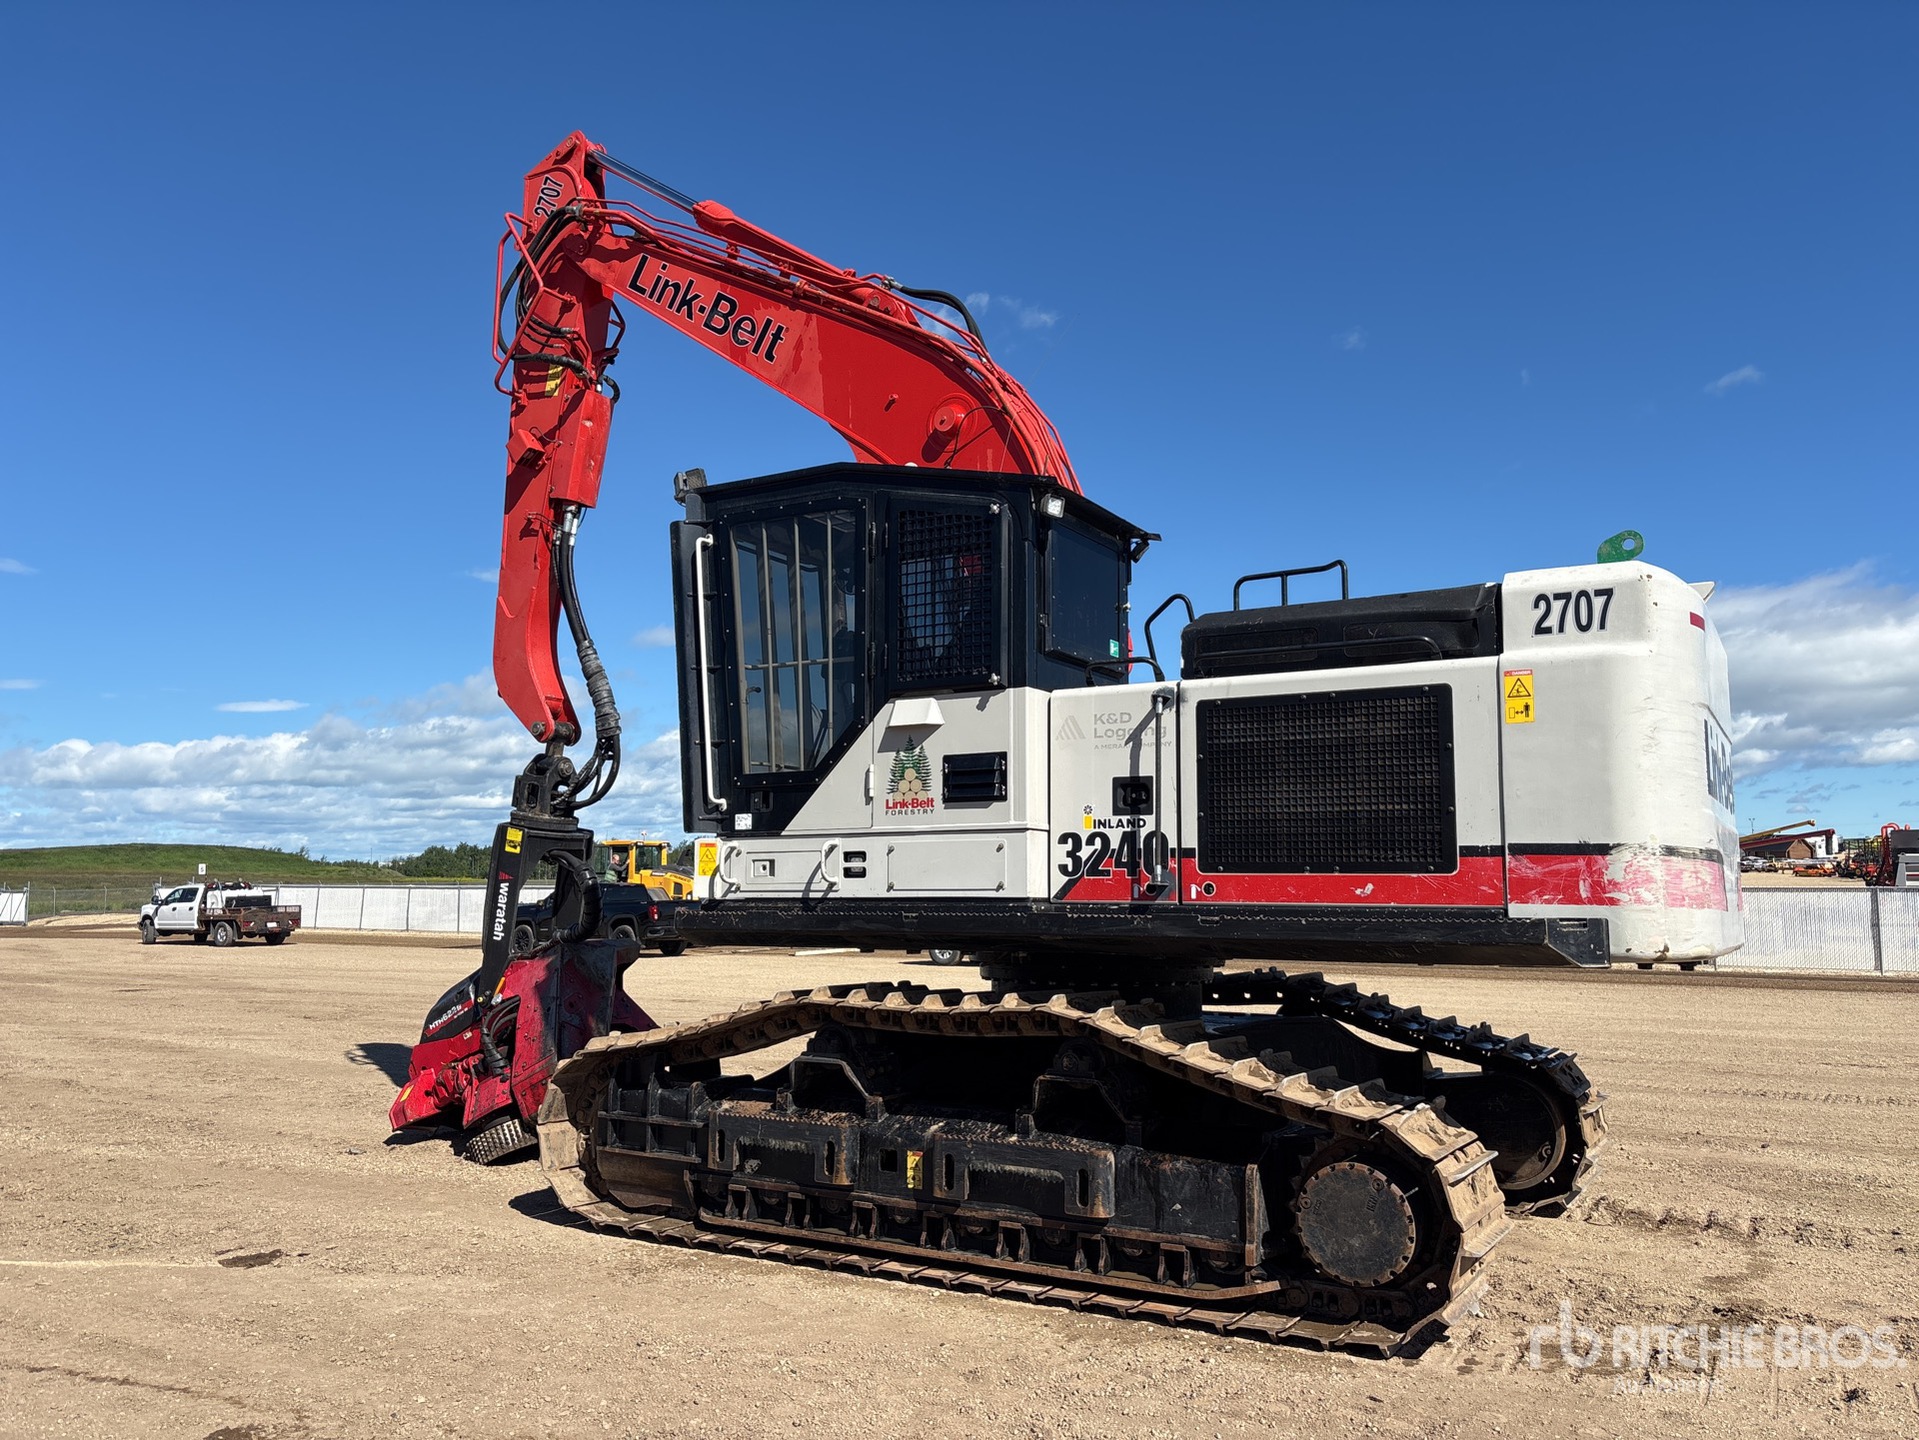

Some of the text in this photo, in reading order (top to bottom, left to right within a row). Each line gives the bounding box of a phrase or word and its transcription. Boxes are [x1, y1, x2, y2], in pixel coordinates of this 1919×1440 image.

[533, 175, 563, 218] 2707
[1532, 587, 1614, 635] 2707
[1094, 712, 1132, 725] K&D
[1057, 831, 1169, 877] 3240
[493, 882, 509, 941] waratah
